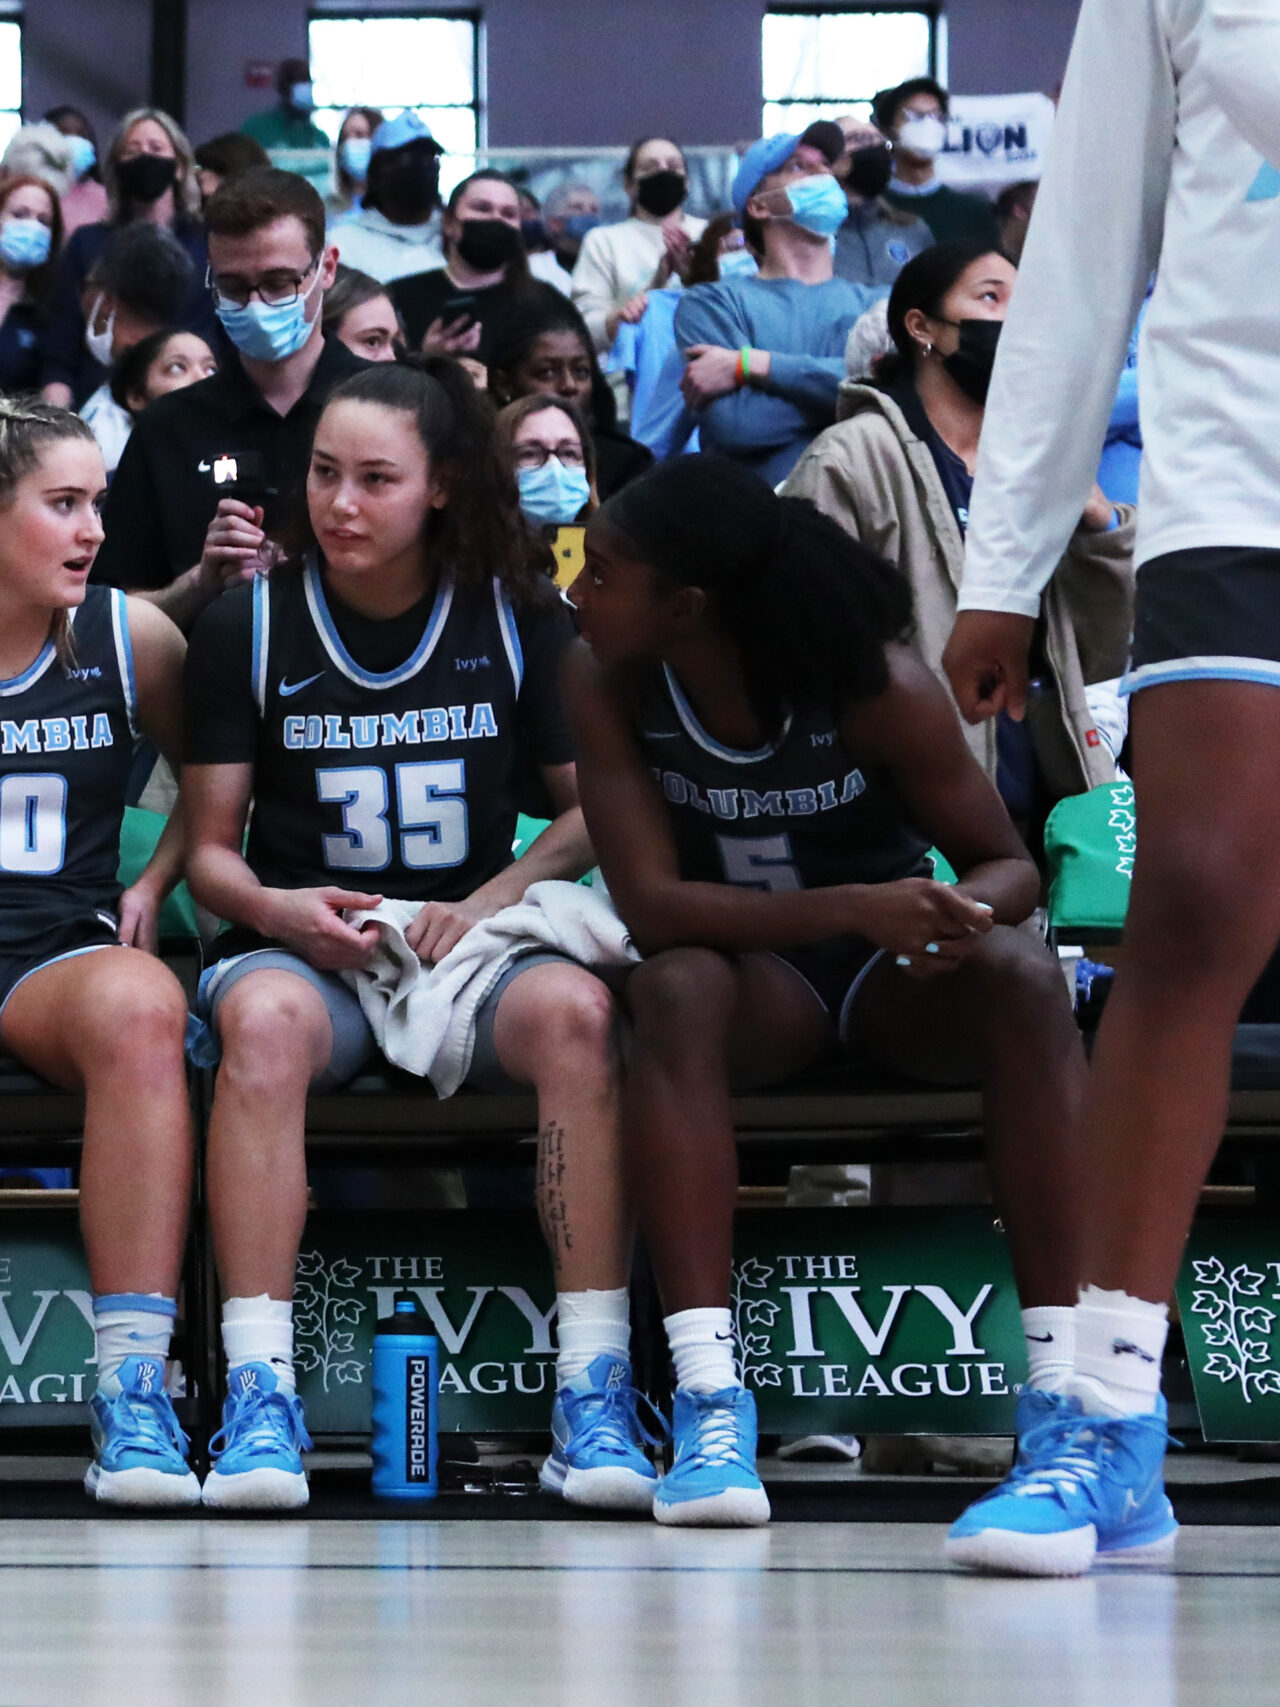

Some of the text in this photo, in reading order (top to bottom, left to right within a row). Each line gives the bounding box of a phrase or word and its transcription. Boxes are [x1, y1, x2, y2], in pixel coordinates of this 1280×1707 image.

[454, 657, 478, 672] Ivy
[283, 702, 498, 750] COLUMBIA
[810, 732, 834, 747] Ivy
[652, 768, 866, 820] OLUMBIA
[315, 758, 470, 872] 35
[715, 832, 805, 891] 5
[366, 1256, 444, 1280] THE
[777, 1255, 859, 1279] THE
[779, 1284, 994, 1357] IVY
[438, 1361, 557, 1394] AGU
[788, 1363, 1009, 1397] LEAGUE
[410, 1359, 426, 1477] POWERADE
